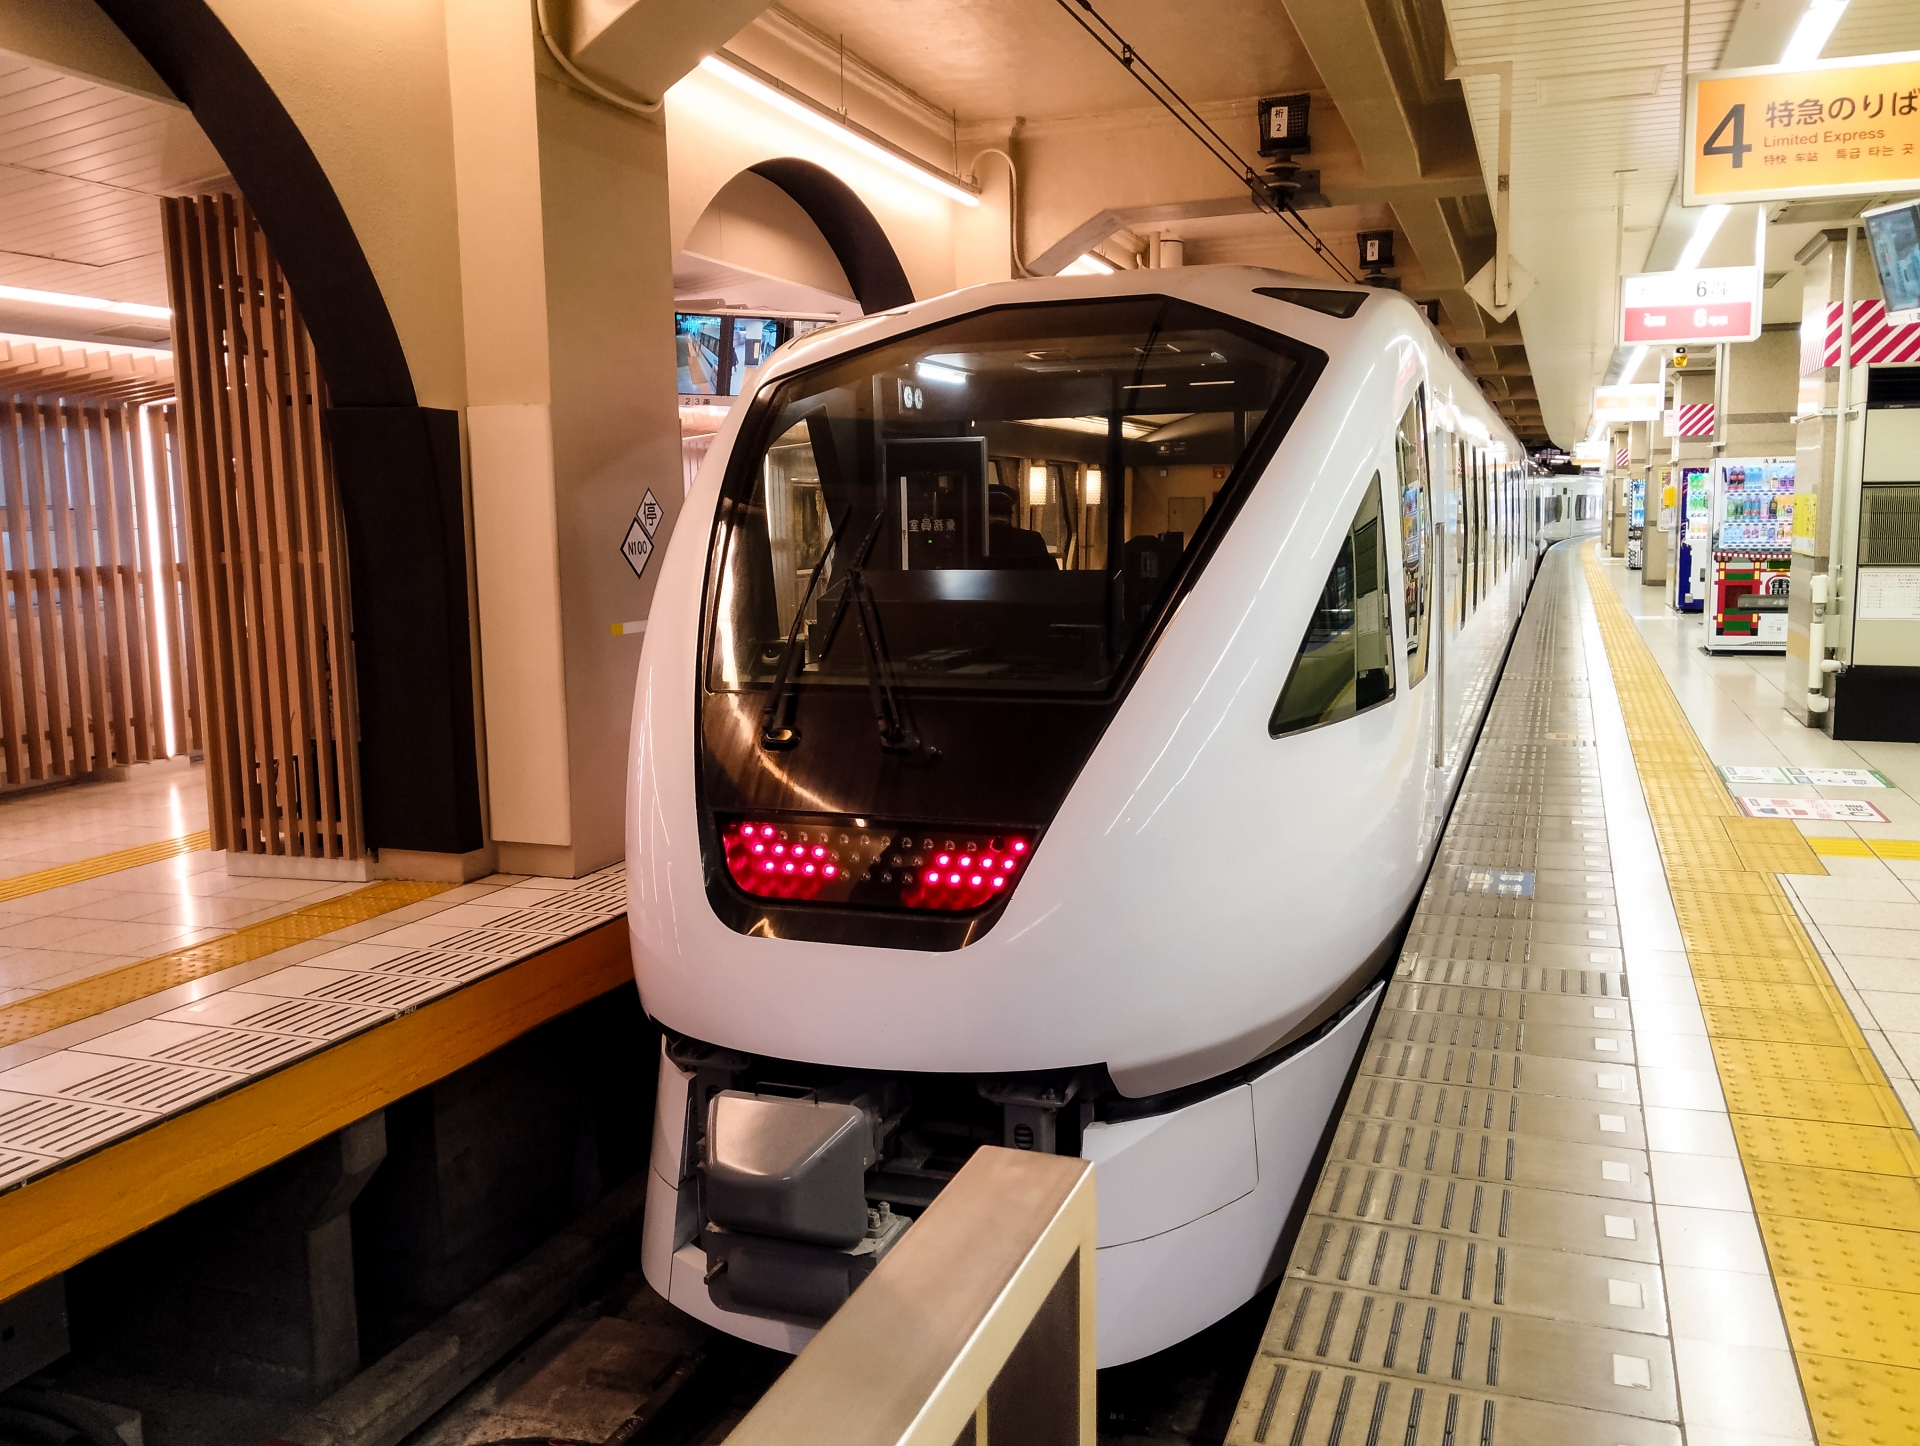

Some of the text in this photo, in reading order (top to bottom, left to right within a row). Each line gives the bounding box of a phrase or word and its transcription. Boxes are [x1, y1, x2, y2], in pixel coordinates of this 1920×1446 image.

[1765, 87, 1920, 128] 特急のりば
[1276, 123, 1282, 132] 2
[1703, 103, 1752, 168] 4
[1764, 128, 1885, 148] Limited Express
[1763, 152, 1818, 166] 特快 车站
[1835, 143, 1915, 160] 특급 타는 곳
[1693, 308, 1707, 327] 6
[643, 501, 657, 526] 停
[627, 540, 648, 556] N100
